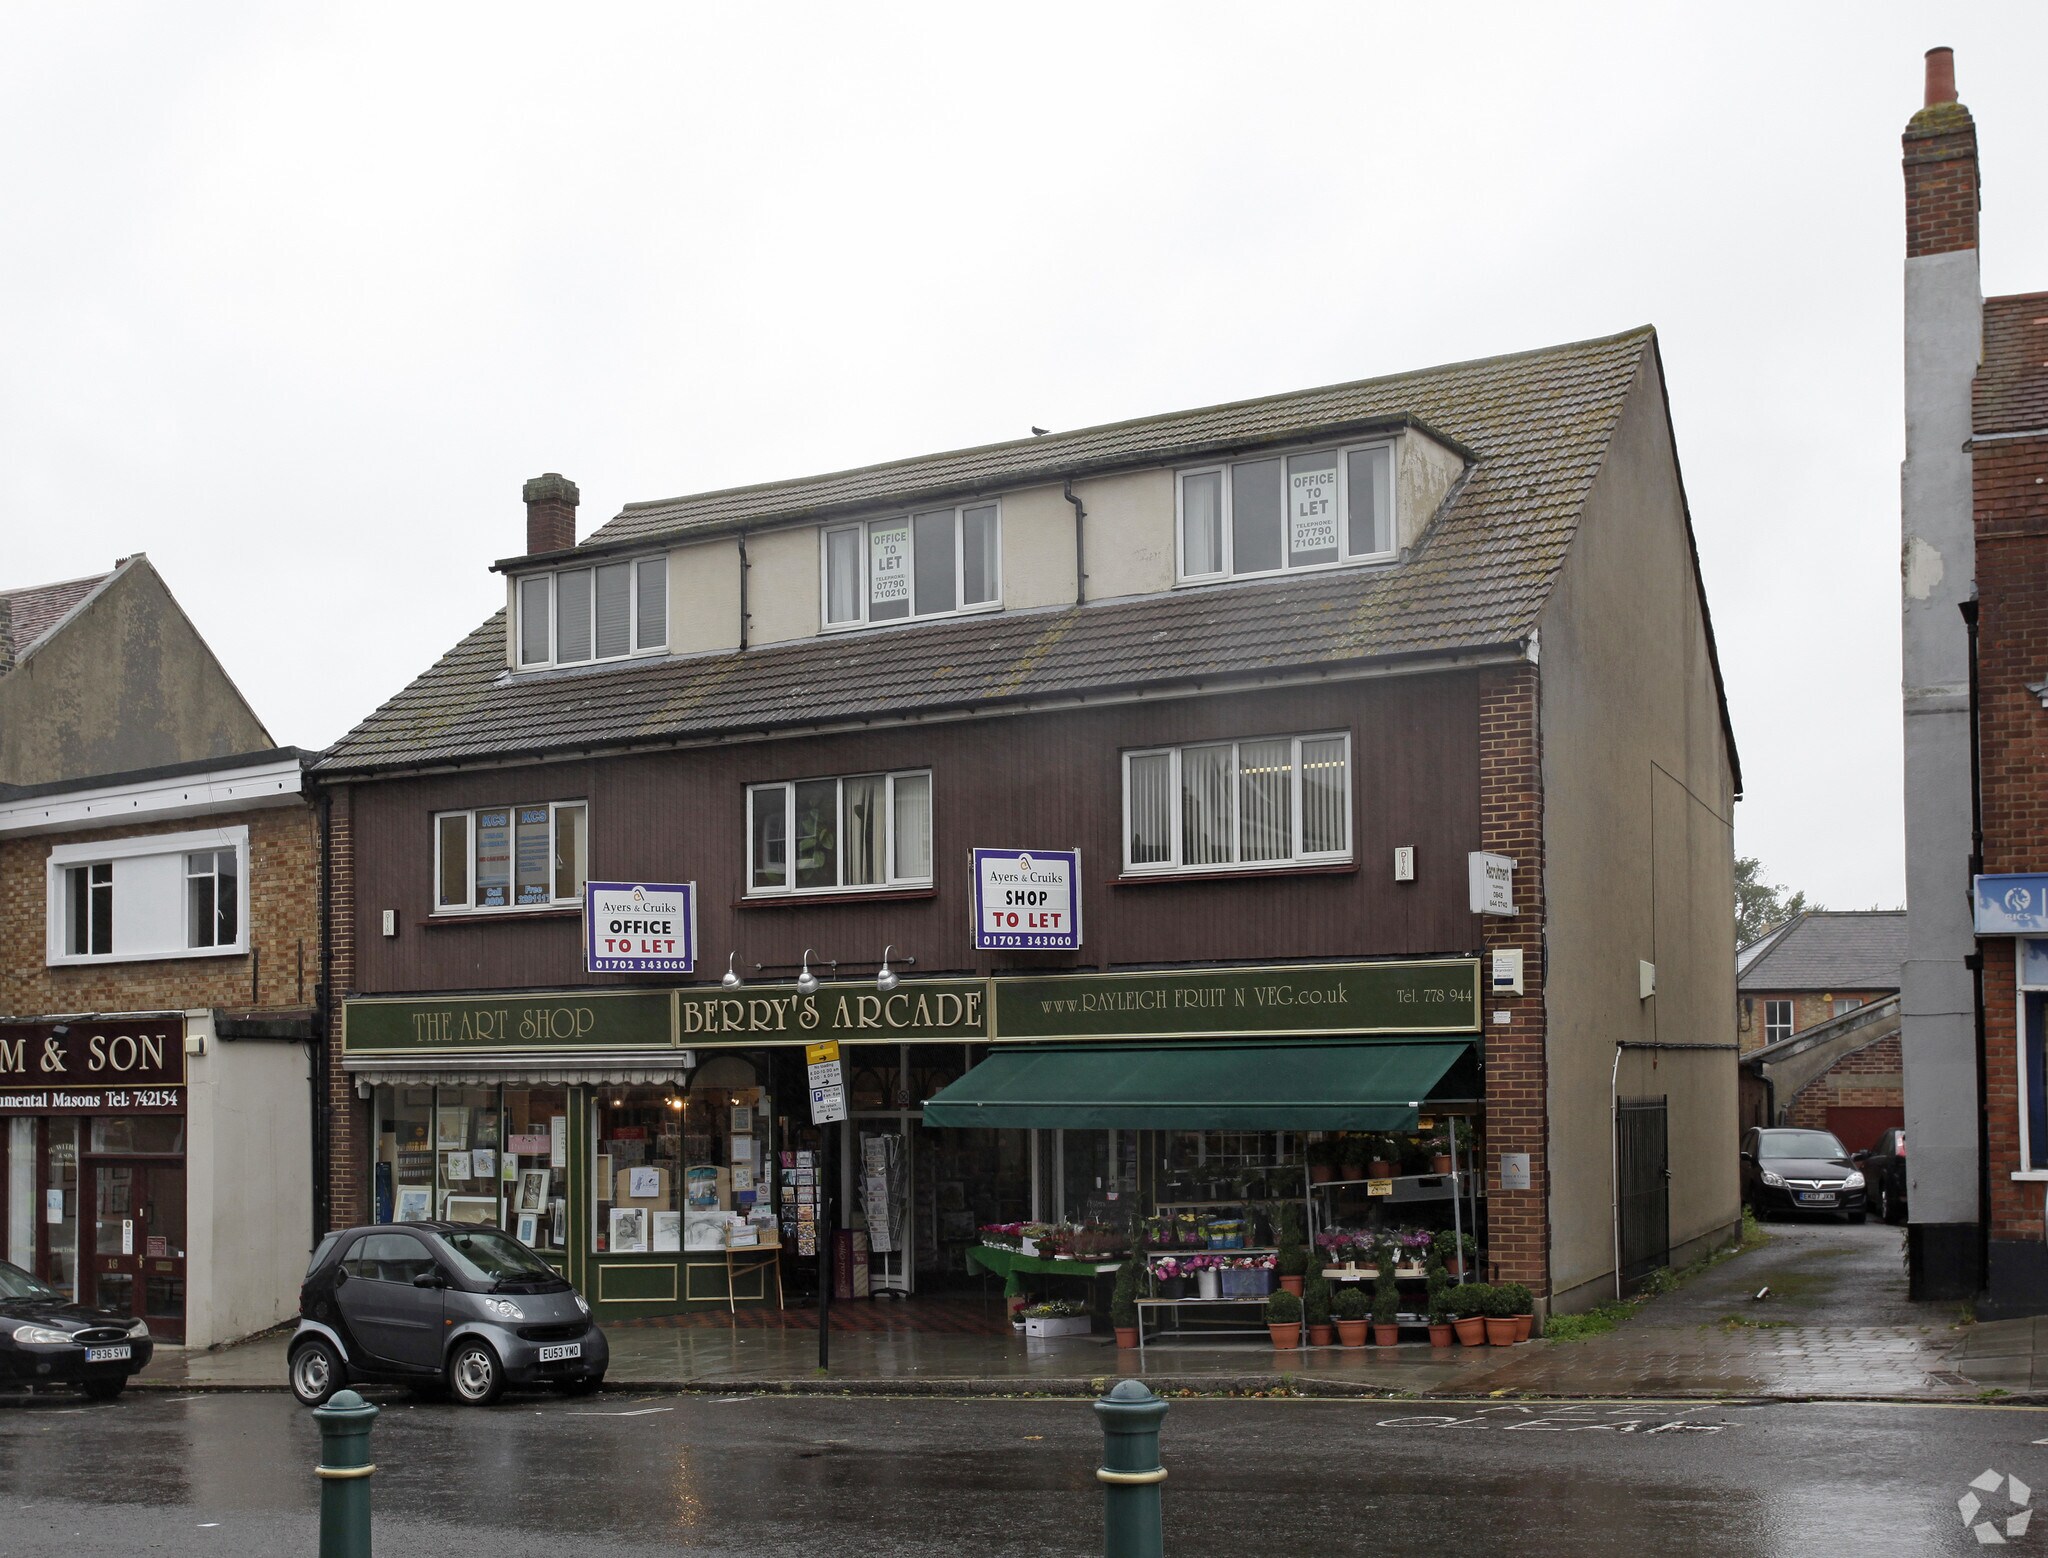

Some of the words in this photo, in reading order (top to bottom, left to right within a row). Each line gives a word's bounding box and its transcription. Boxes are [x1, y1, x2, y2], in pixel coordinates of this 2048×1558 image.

[1294, 473, 1334, 488] OFFICE
[1306, 488, 1321, 498] TO
[1300, 499, 1328, 516] LET
[874, 532, 906, 545] OFFICE
[1297, 526, 1331, 538] 07790
[1294, 535, 1335, 548] 710210
[884, 545, 896, 555] TO
[879, 556, 902, 571] LET
[877, 580, 904, 590] 07790
[874, 588, 907, 599] 710210
[482, 814, 506, 826] KCS
[521, 810, 546, 823] KCS
[990, 871, 1018, 884] Ayers
[1030, 872, 1062, 883] Cruiks
[1006, 890, 1047, 906] SHOP
[603, 902, 631, 914] Ayers
[643, 903, 676, 913] Cruiks
[993, 912, 1019, 927] TO
[1029, 913, 1062, 928] LET
[610, 920, 671, 934] OFFICE
[605, 939, 631, 952] TO
[642, 940, 675, 953] LET
[983, 936, 1021, 945] 01702
[1028, 936, 1071, 945] 343060
[596, 960, 634, 969] 01702
[640, 961, 685, 969] 343060
[1174, 987, 1226, 1009] FRUIT
[1235, 987, 1246, 1007] N
[1254, 982, 1348, 1007] VEG.co.uk
[1424, 989, 1445, 1002] 778
[1449, 988, 1472, 1002] 944
[683, 994, 820, 1034] BERRY'S
[832, 990, 982, 1029] ARCADE
[413, 1012, 452, 1042] THE
[459, 1010, 508, 1040] ART
[519, 1007, 595, 1039] SHOP
[0, 1039, 26, 1073] M
[40, 1037, 68, 1072] &
[88, 1035, 166, 1072] SON
[52, 1092, 100, 1107] Masons
[105, 1091, 130, 1106] Tel:
[133, 1090, 178, 1106] 742154
[56, 1143, 75, 1151] WITH
[108, 1259, 118, 1269] 16
[91, 1349, 112, 1360] P936
[114, 1348, 129, 1357] SVV
[543, 1347, 563, 1359] EU53
[565, 1346, 578, 1356] YMO
